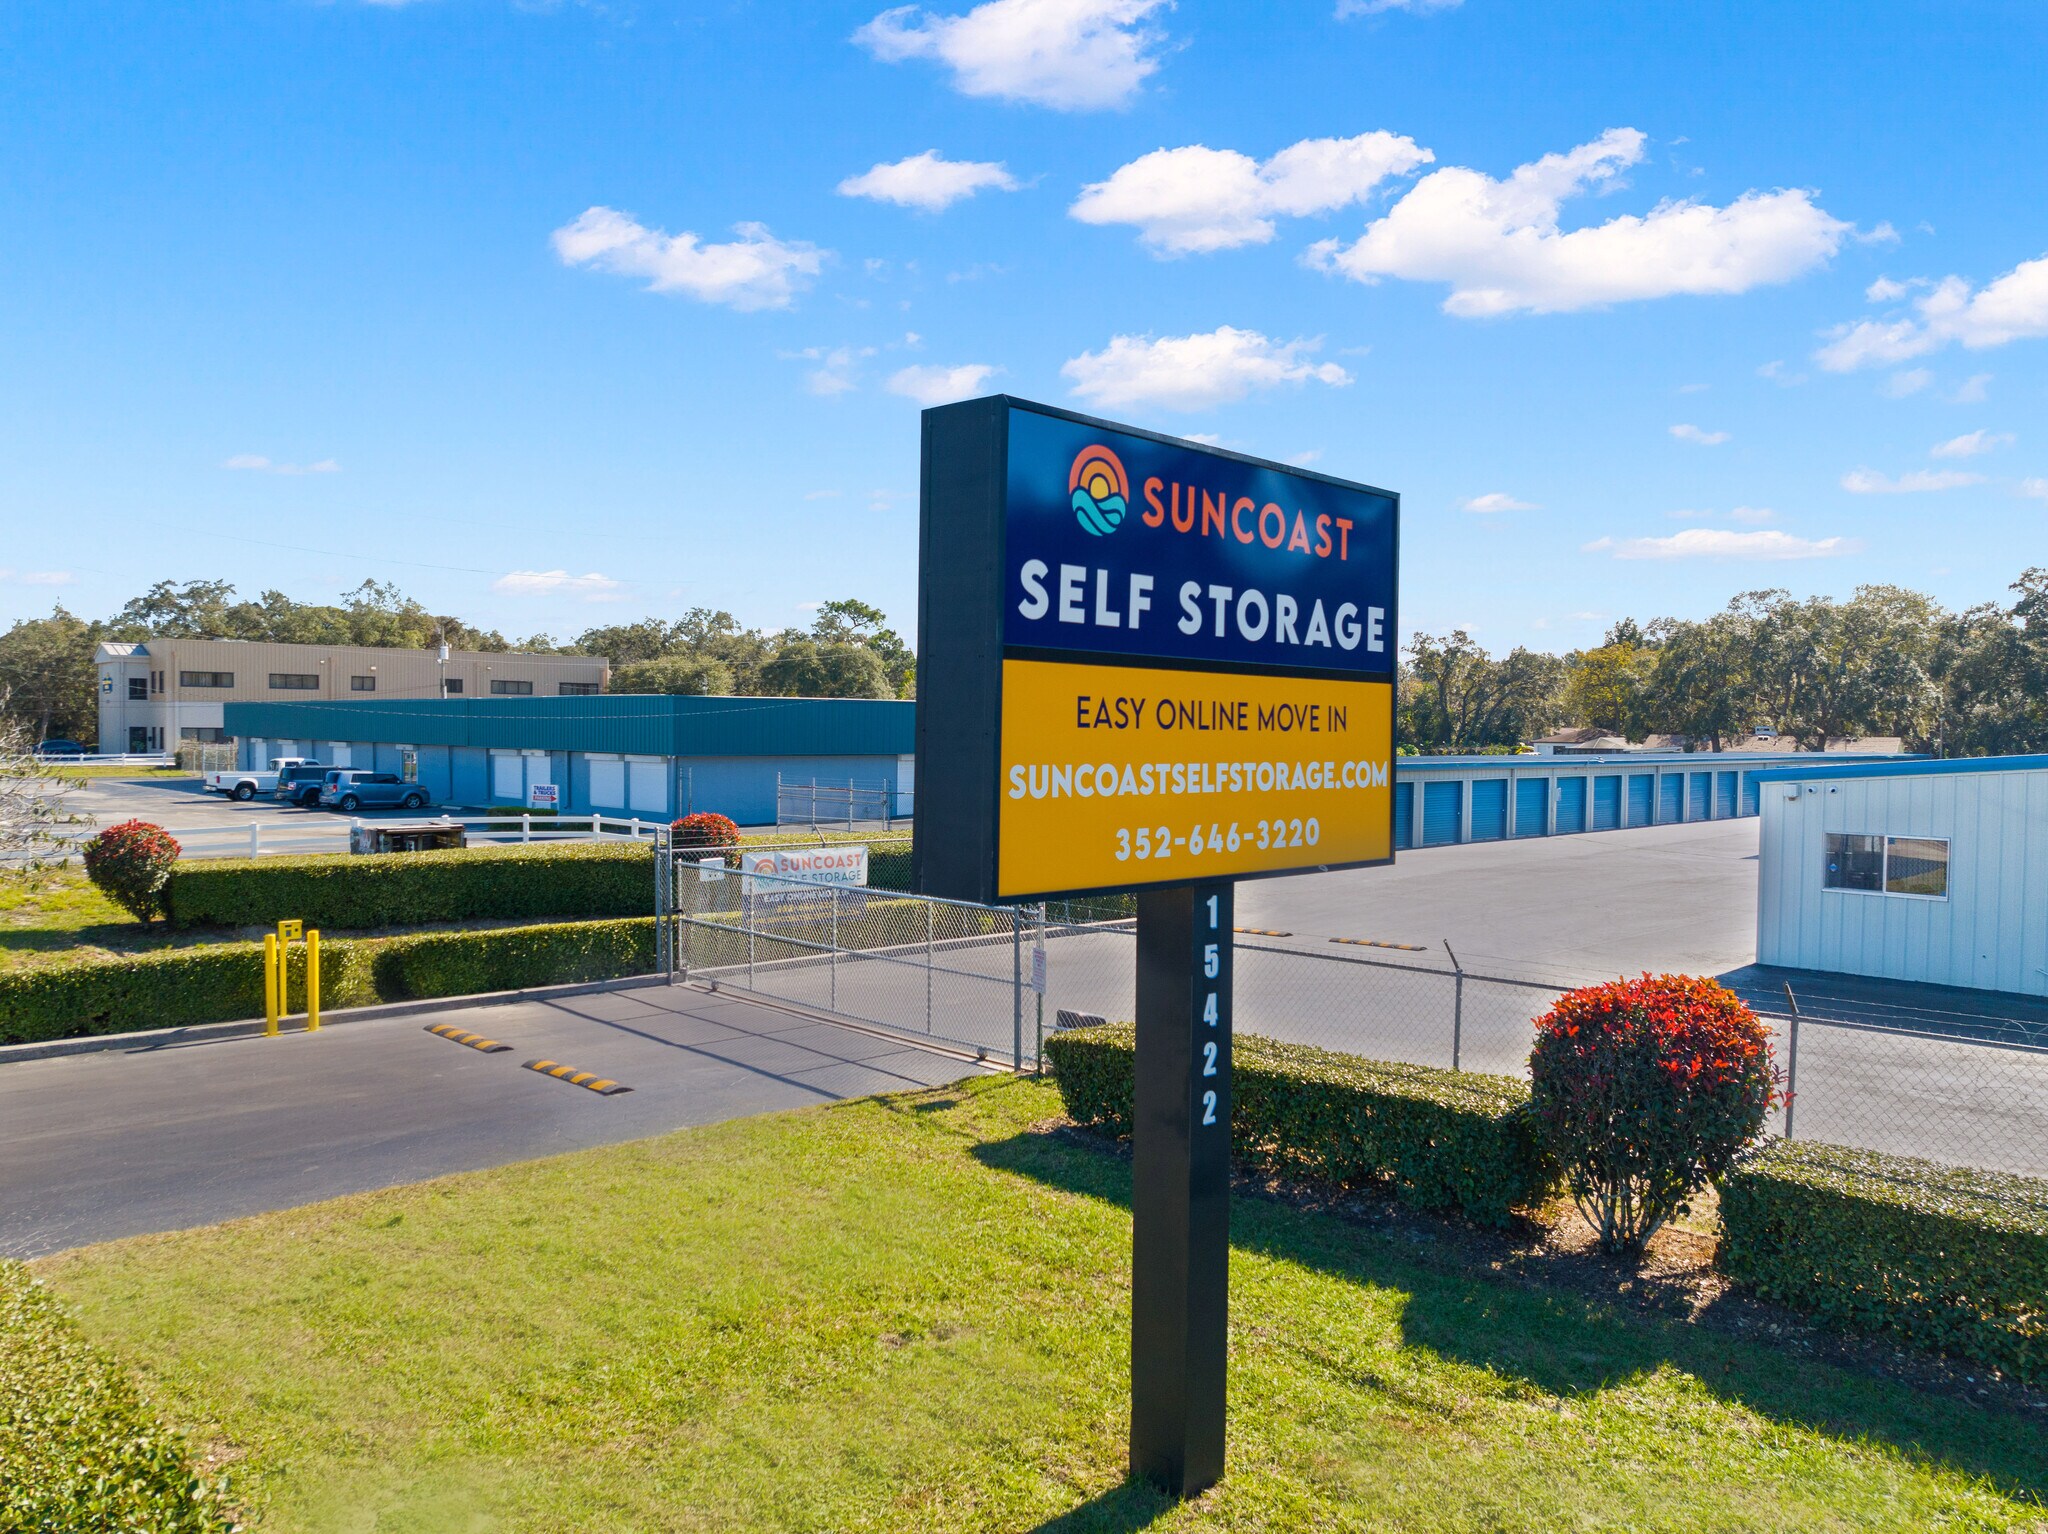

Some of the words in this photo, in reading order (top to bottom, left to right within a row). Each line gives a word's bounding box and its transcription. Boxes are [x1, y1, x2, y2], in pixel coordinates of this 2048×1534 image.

[1141, 476, 1353, 561] SUNCOAST
[1017, 558, 1154, 630] SELF
[1177, 580, 1385, 653] STORAGE
[1077, 695, 1146, 730] EASY
[1156, 698, 1248, 732] ONLINE
[1257, 703, 1320, 732] MOVE
[1328, 706, 1347, 732] IN
[1008, 760, 1388, 800] SUNCOASTSELFSTORAGE.COM
[1115, 817, 1320, 861] 352-646-3220
[781, 854, 861, 872] SUNCOAST
[812, 870, 861, 883] STORAGE
[1202, 894, 1219, 1126] 15422
